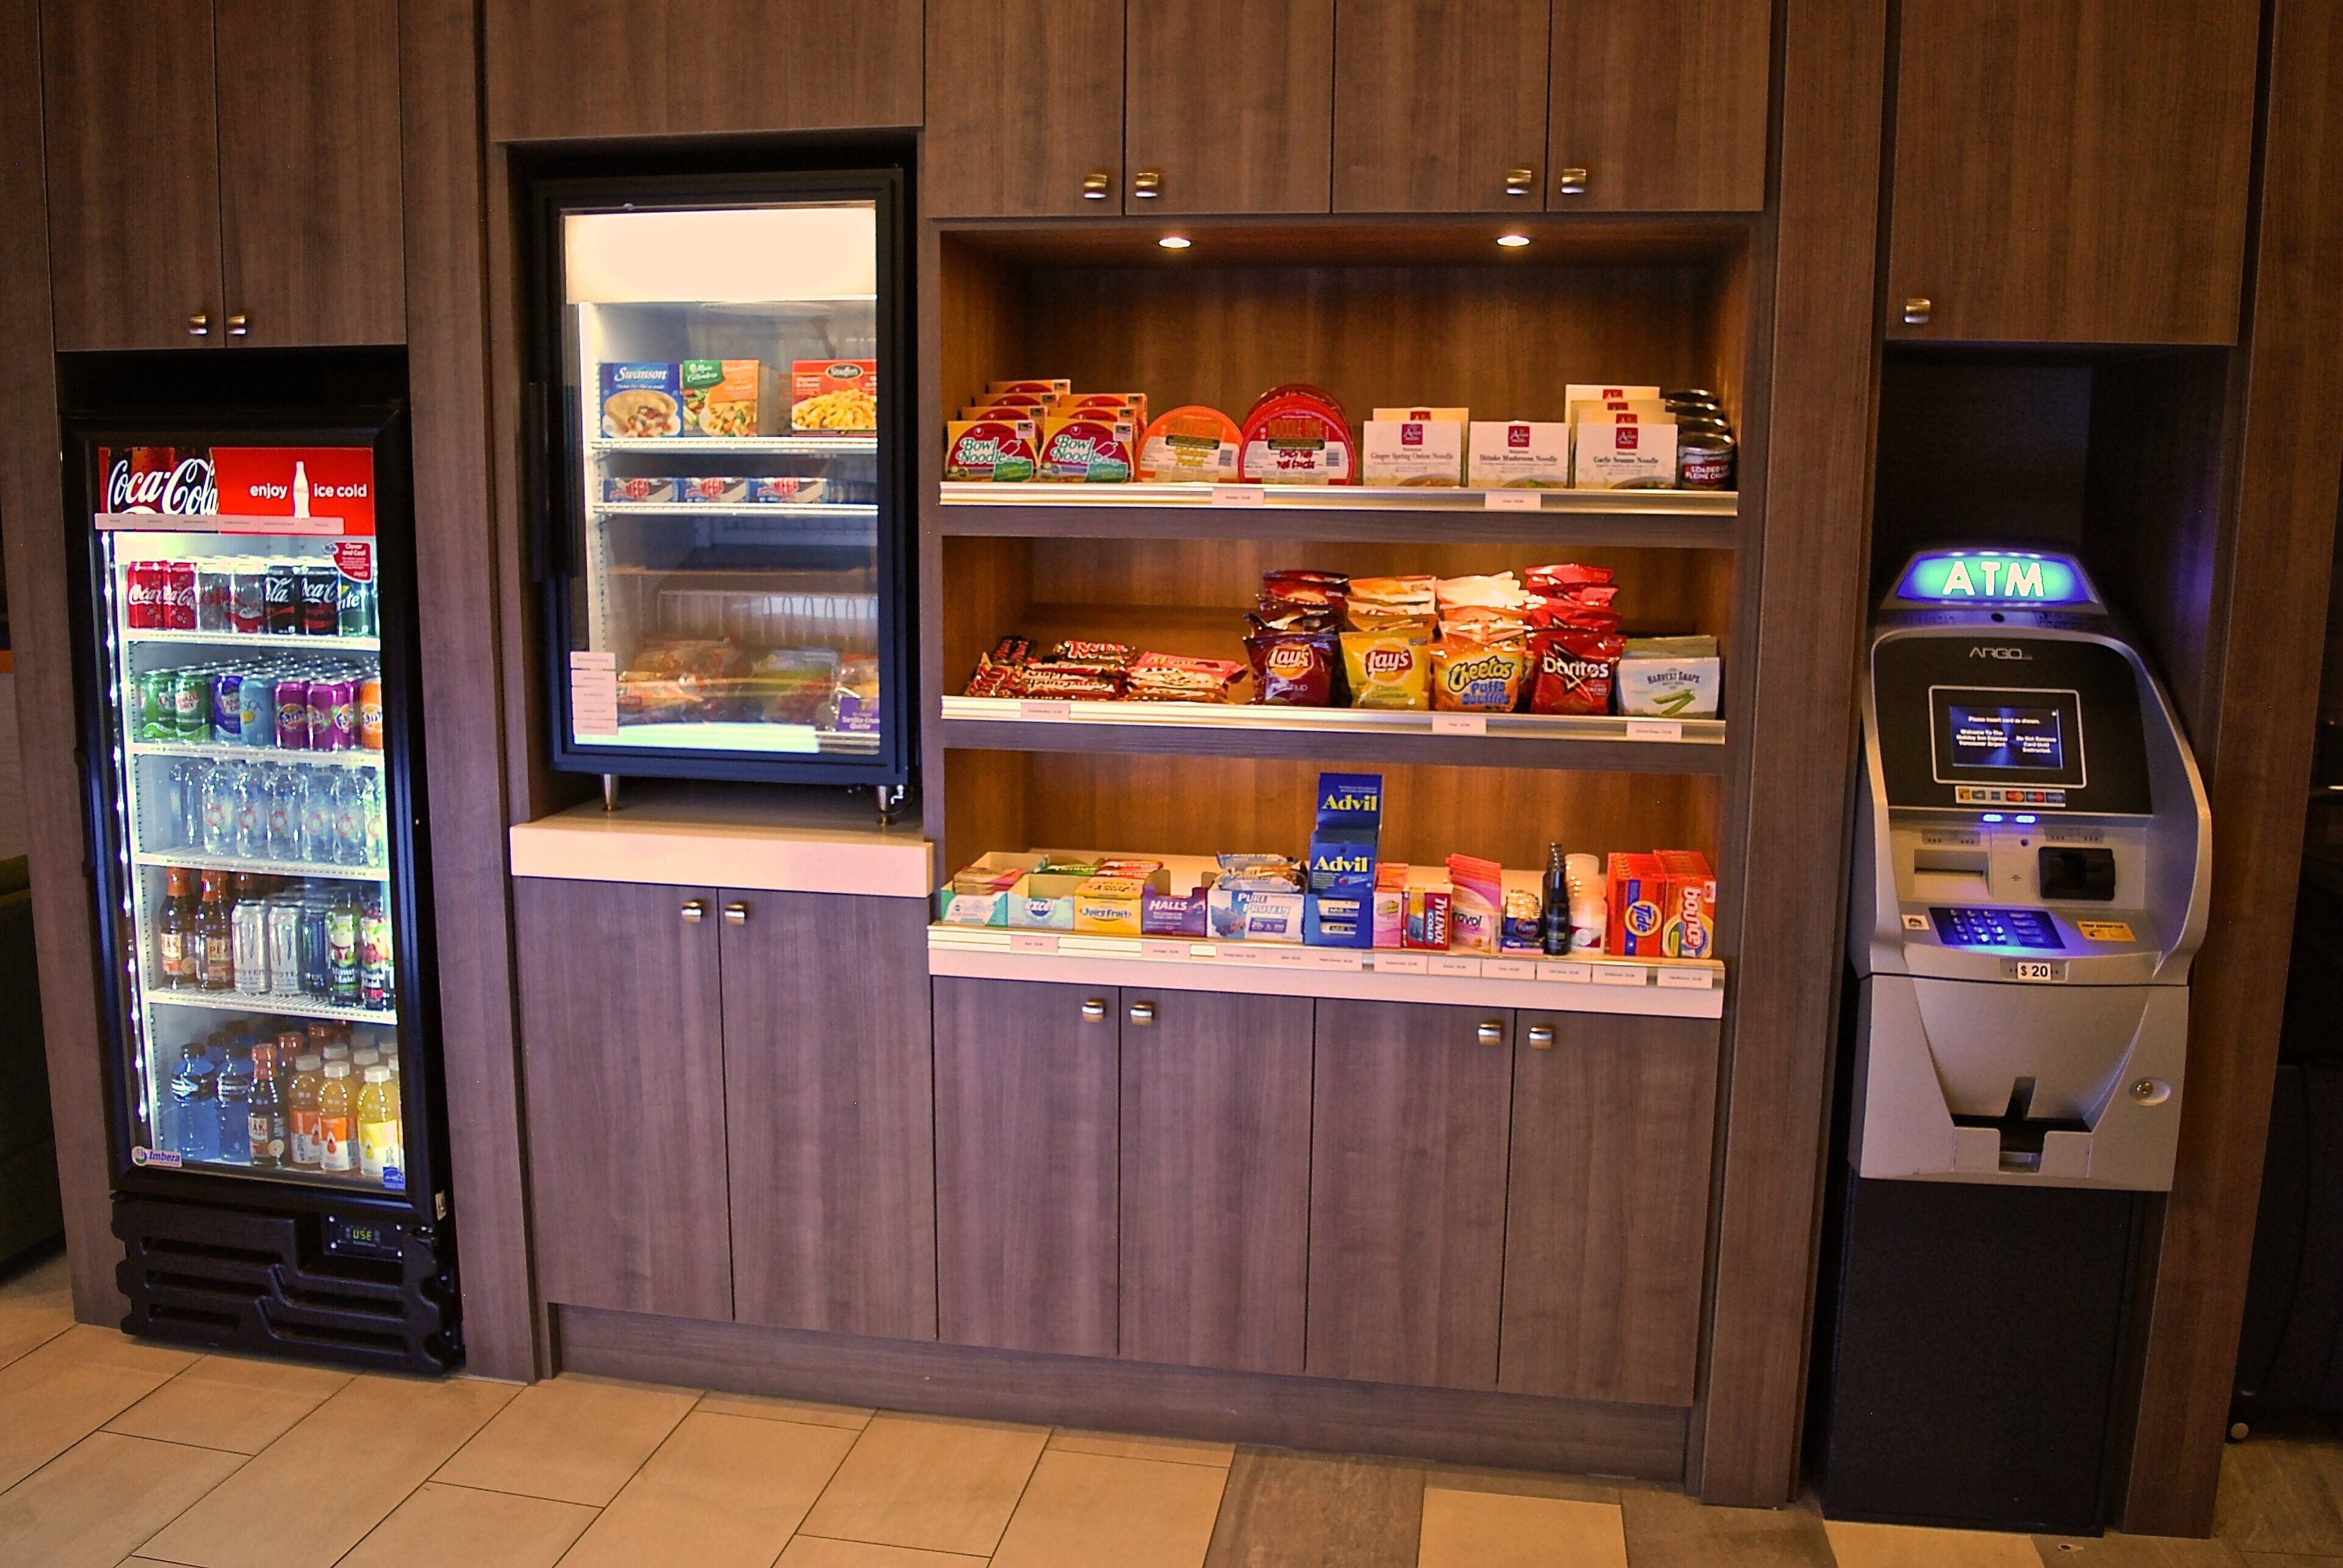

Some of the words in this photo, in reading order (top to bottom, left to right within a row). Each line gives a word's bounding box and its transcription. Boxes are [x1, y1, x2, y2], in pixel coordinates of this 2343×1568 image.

[614, 367, 668, 382] Swanson
[960, 436, 999, 451] Bowl
[1057, 435, 1096, 451] Bowl
[957, 450, 1006, 464] Noodle
[1051, 448, 1101, 464] Noodle
[108, 458, 219, 515] Coca-Cola
[250, 484, 287, 499] enjoy
[314, 483, 334, 498] ice
[336, 483, 367, 498] cold
[1943, 561, 2045, 597] ATM
[1969, 647, 2023, 660] ARGO
[1448, 655, 1514, 692] Cheetos
[1543, 657, 1609, 678] Doritos
[1647, 672, 1677, 685] HARVEST
[1678, 671, 1701, 684] SNAPS
[1470, 682, 1505, 694] Puffs
[1322, 794, 1377, 811] Advil
[1314, 856, 1368, 872] Advil
[1150, 900, 1187, 911] HALLS
[1237, 893, 1268, 903] PURE
[1084, 908, 1106, 917] Juicy
[1107, 909, 1128, 918] Fruit
[1243, 904, 1292, 915] PROTEIN
[1435, 897, 1447, 945] TYLENOL
[1452, 912, 1482, 927] ravol
[1632, 905, 1653, 933] Tide
[2021, 965, 2027, 977] $
[2031, 965, 2048, 977] 20
